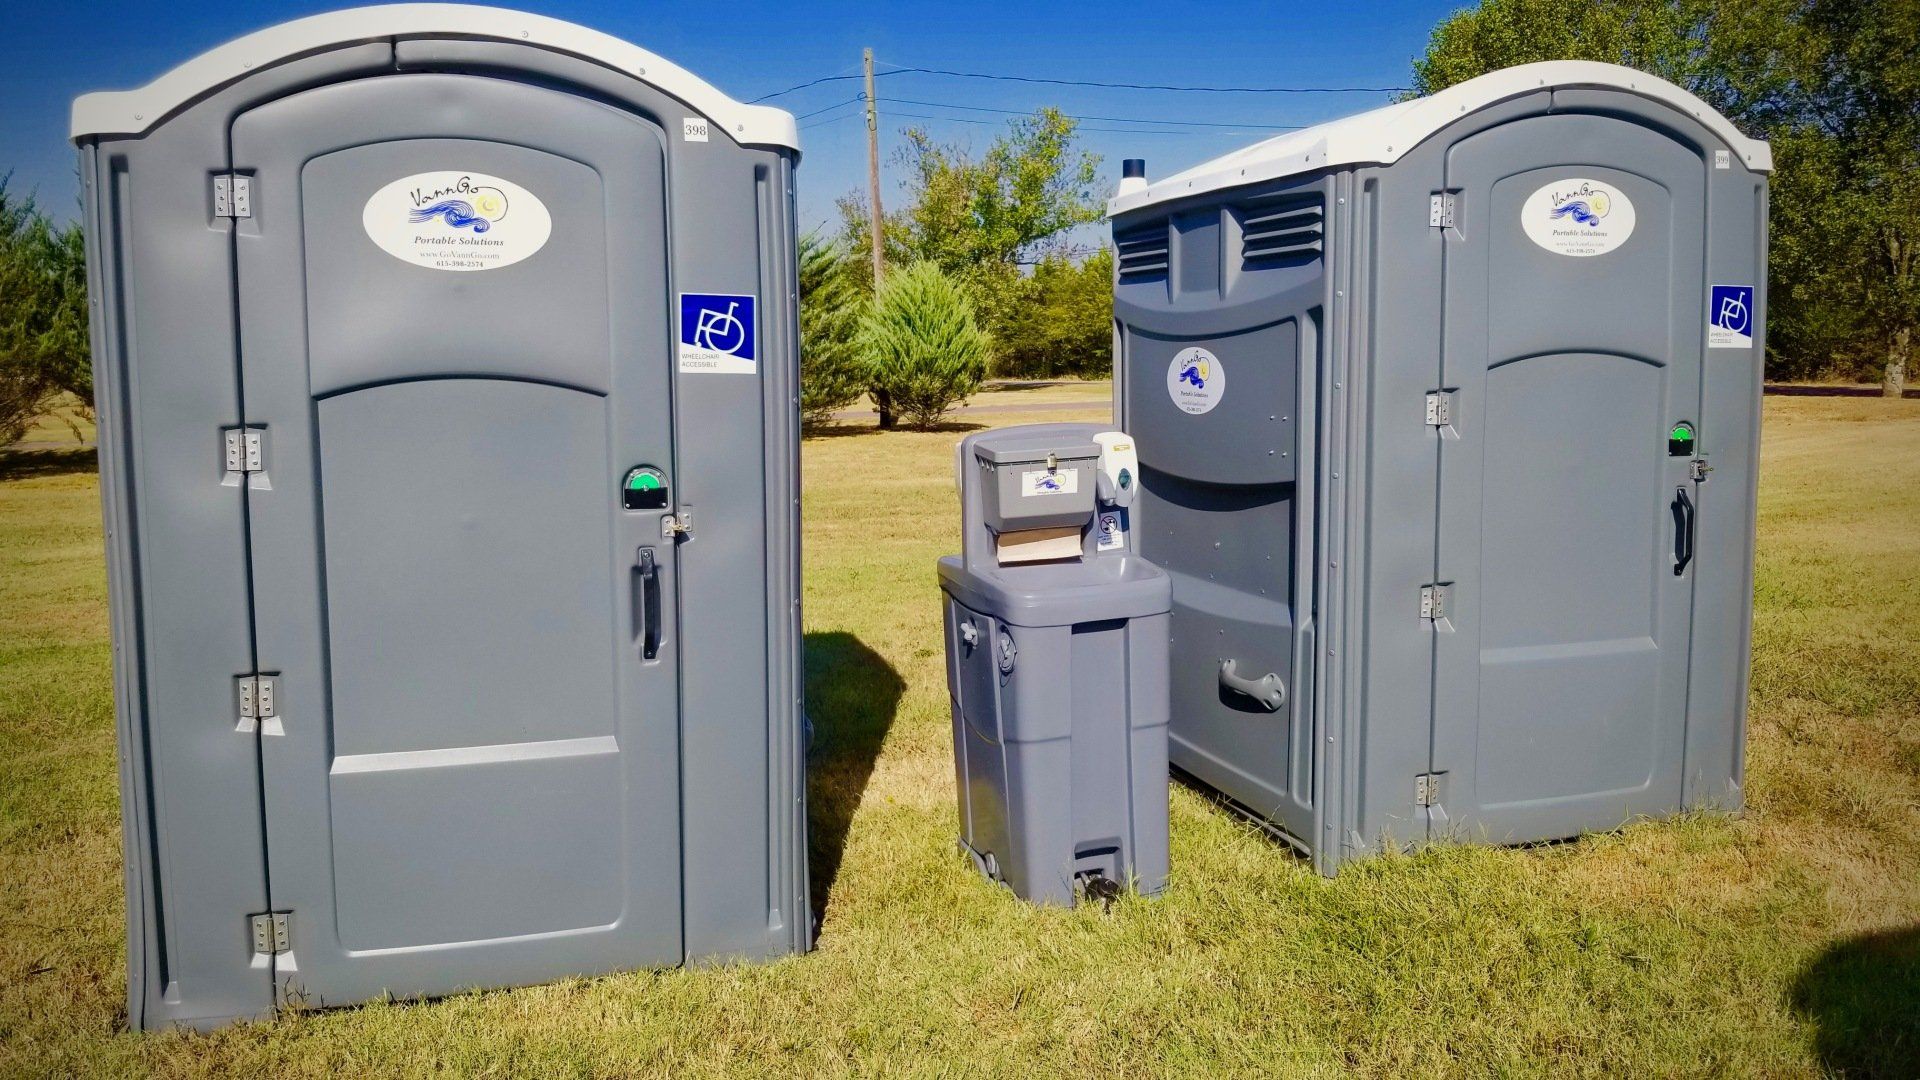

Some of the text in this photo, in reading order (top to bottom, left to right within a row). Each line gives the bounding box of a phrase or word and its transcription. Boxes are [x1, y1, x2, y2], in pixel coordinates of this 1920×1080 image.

[685, 124, 707, 136] 398
[1716, 155, 1729, 165] 399
[410, 176, 479, 207] VannGo
[1552, 182, 1594, 207] VannGo
[1580, 229, 1608, 237] Solutions
[414, 236, 504, 246] Portable Solutions
